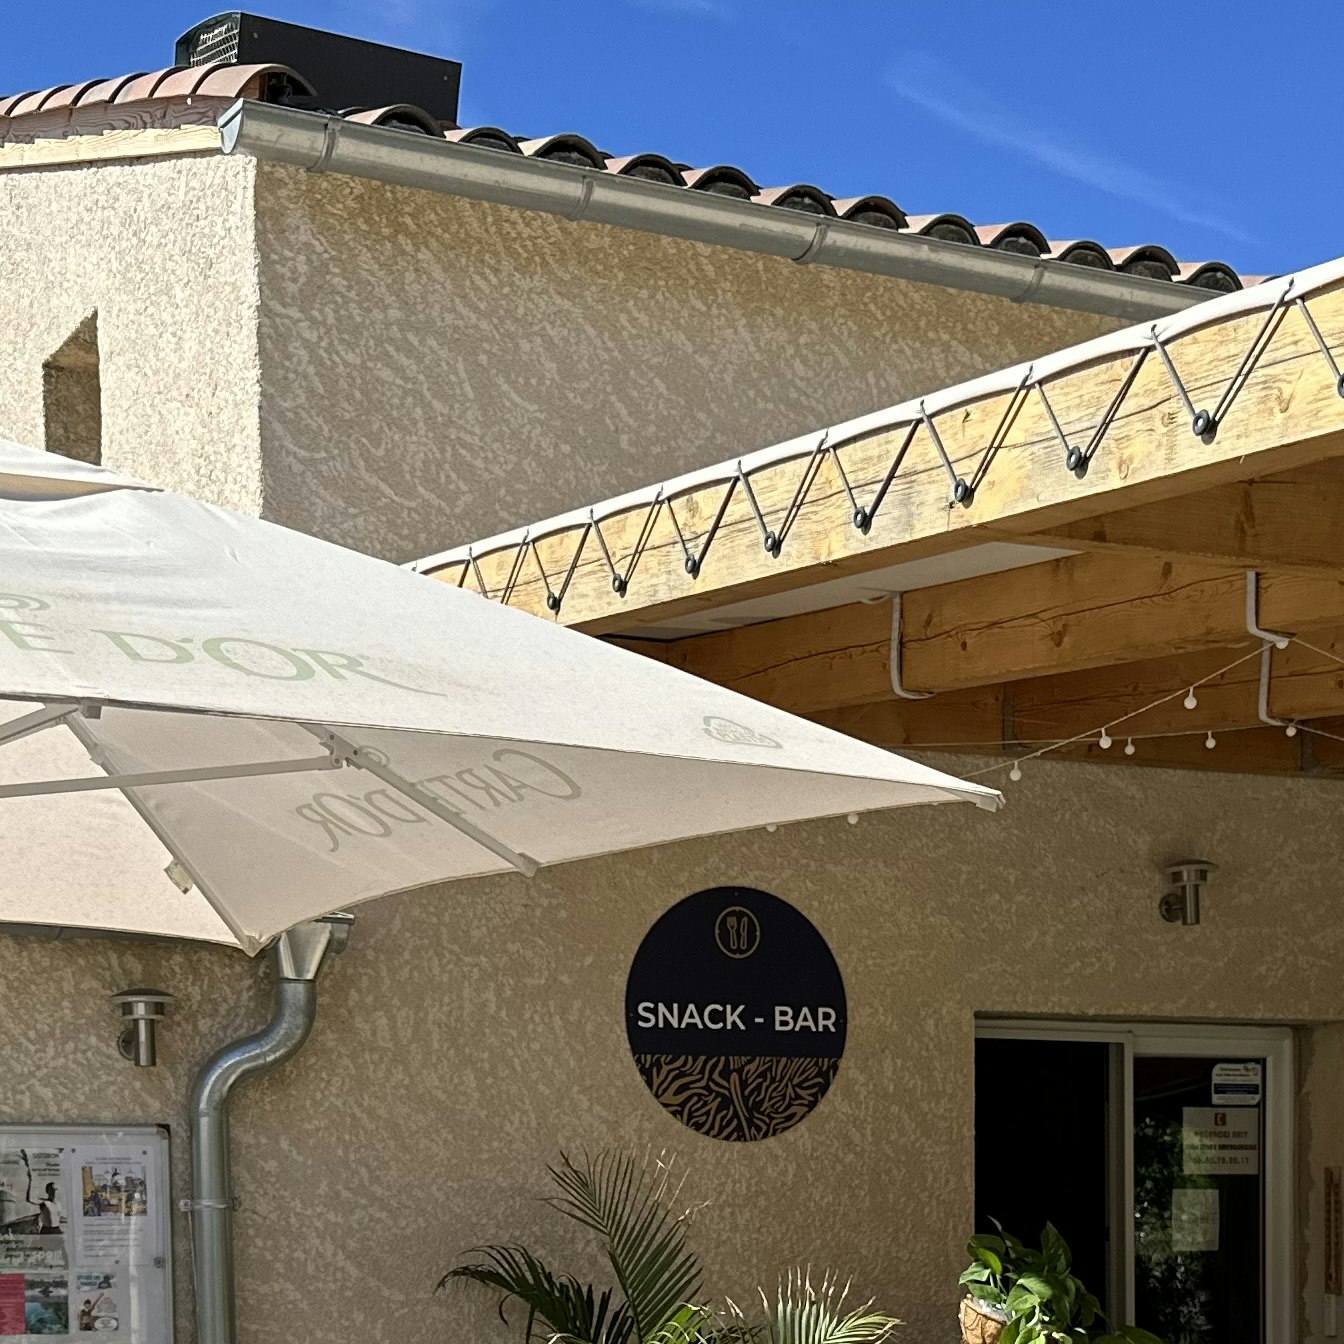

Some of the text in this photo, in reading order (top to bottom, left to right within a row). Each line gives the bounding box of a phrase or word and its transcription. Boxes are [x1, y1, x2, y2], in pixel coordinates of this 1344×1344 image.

[89, 628, 447, 696] D'OR
[637, 1001, 747, 1032] SNACK
[774, 1006, 837, 1033] BAR
